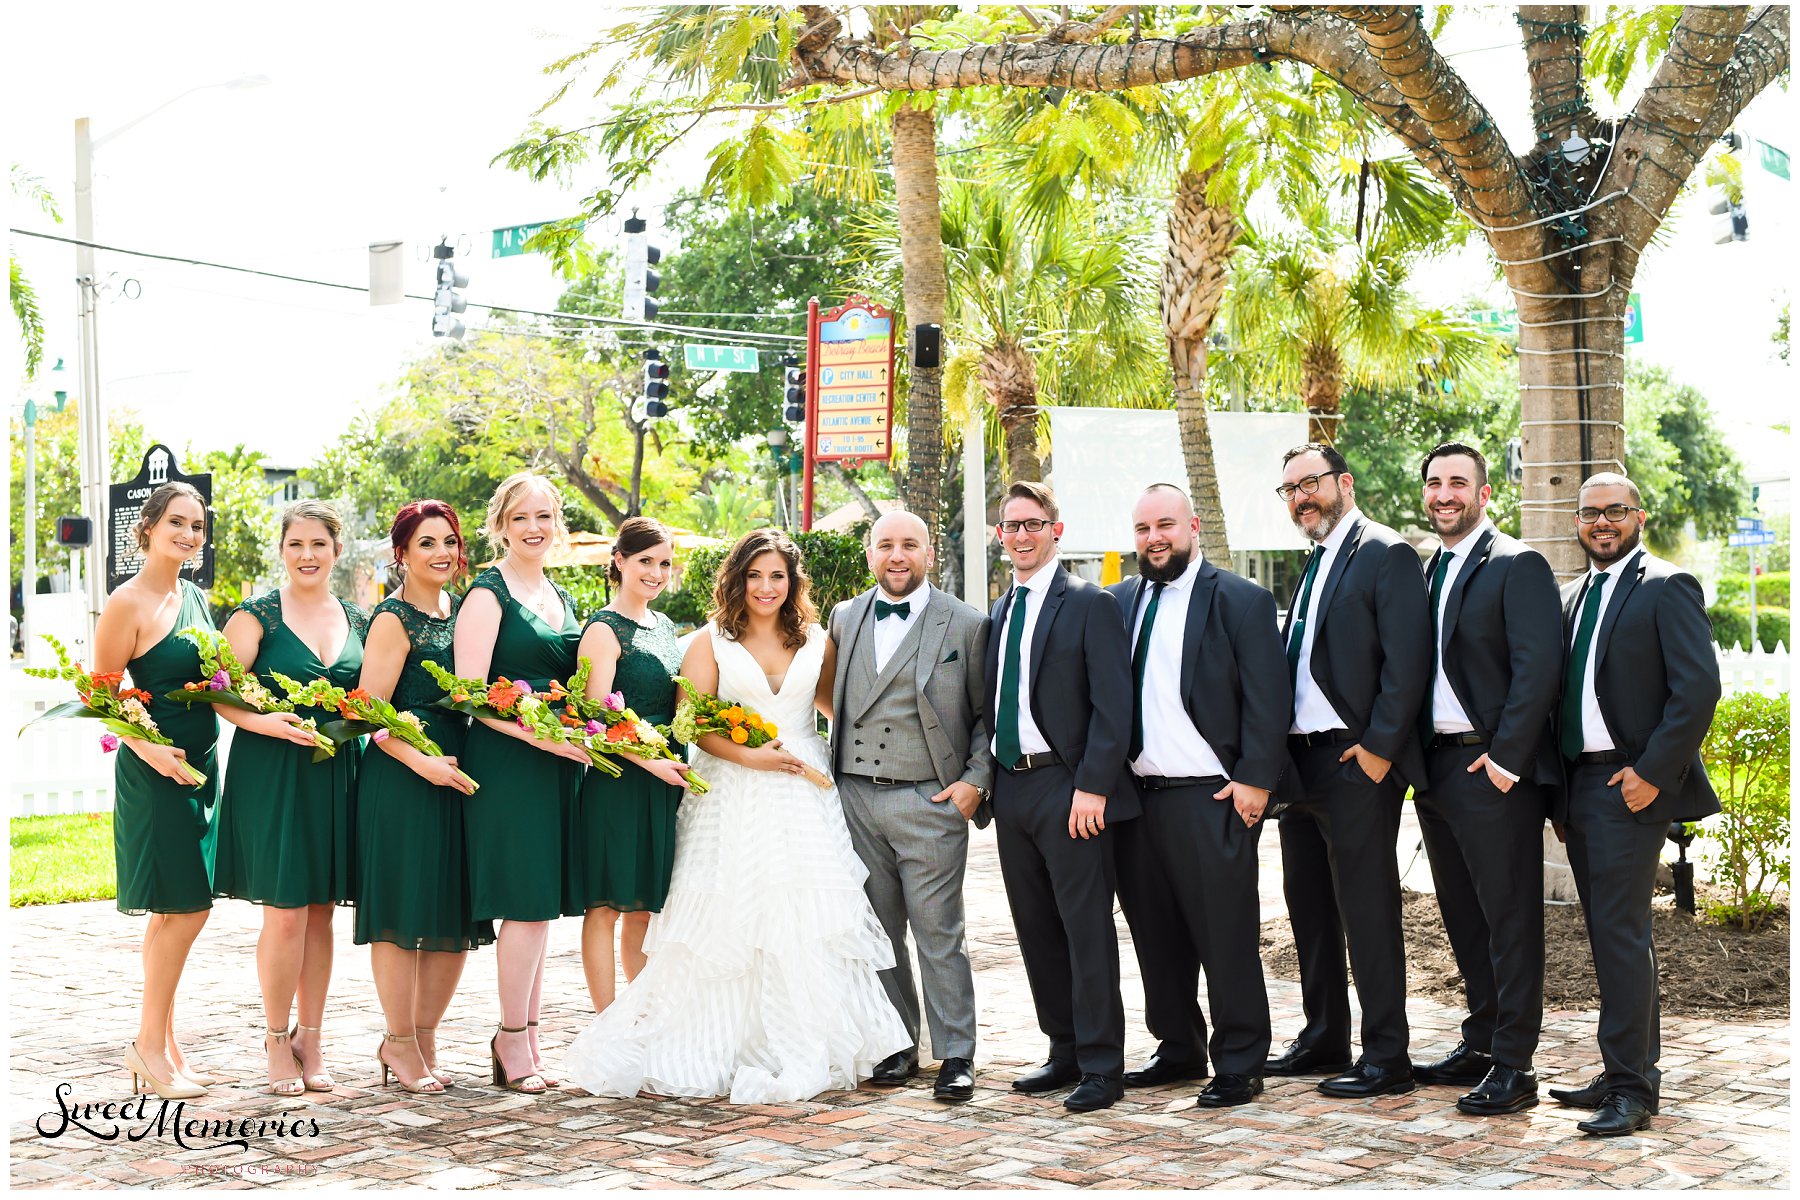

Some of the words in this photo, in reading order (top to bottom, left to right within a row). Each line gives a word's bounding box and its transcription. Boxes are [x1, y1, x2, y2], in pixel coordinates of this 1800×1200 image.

[502, 229, 512, 248] N
[697, 346, 705, 361] N
[733, 349, 745, 364] St
[822, 342, 856, 360] Delray
[858, 338, 887, 354] Beach
[840, 371, 854, 380] CITY
[857, 370, 873, 379] HALL
[822, 394, 854, 404] RECREATION
[856, 393, 877, 402] CENTER
[822, 416, 848, 426] ATLANTIC
[850, 416, 872, 425] AVENUE
[127, 487, 152, 500] CASON
